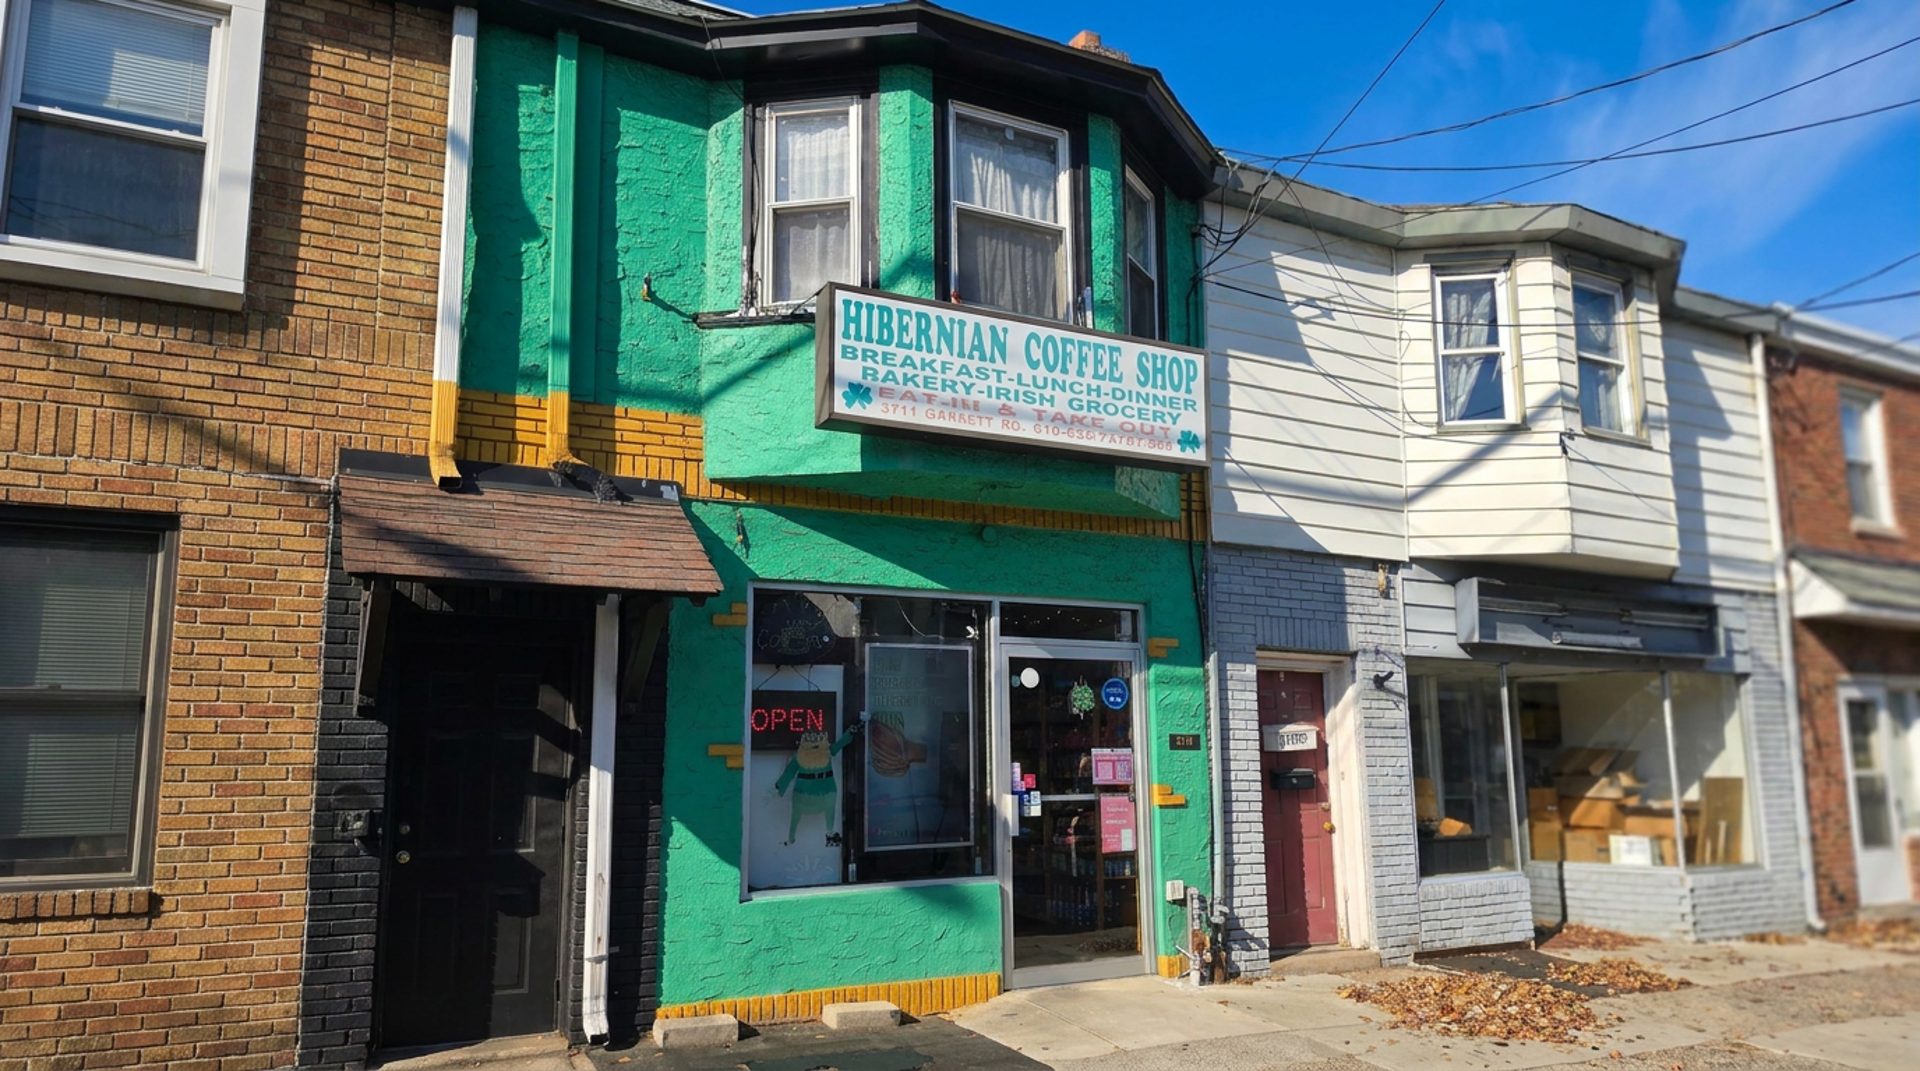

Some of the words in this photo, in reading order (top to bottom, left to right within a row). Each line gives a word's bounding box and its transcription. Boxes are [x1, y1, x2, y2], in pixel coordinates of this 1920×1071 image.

[841, 299, 1008, 365] HIBERNIAN
[1024, 332, 1123, 383] COFFEE
[1136, 351, 1198, 394] SHOP
[841, 344, 1198, 412] BREAKFAST-LUNCH-DINNER
[862, 366, 1056, 408] BAKERY-IRISH
[1068, 397, 1182, 426] GROCERY
[881, 402, 917, 417] 3711
[998, 403, 1016, 417] &
[1032, 408, 1105, 429] TAKE
[1119, 421, 1171, 439] OUT
[751, 708, 823, 732] OPEN
